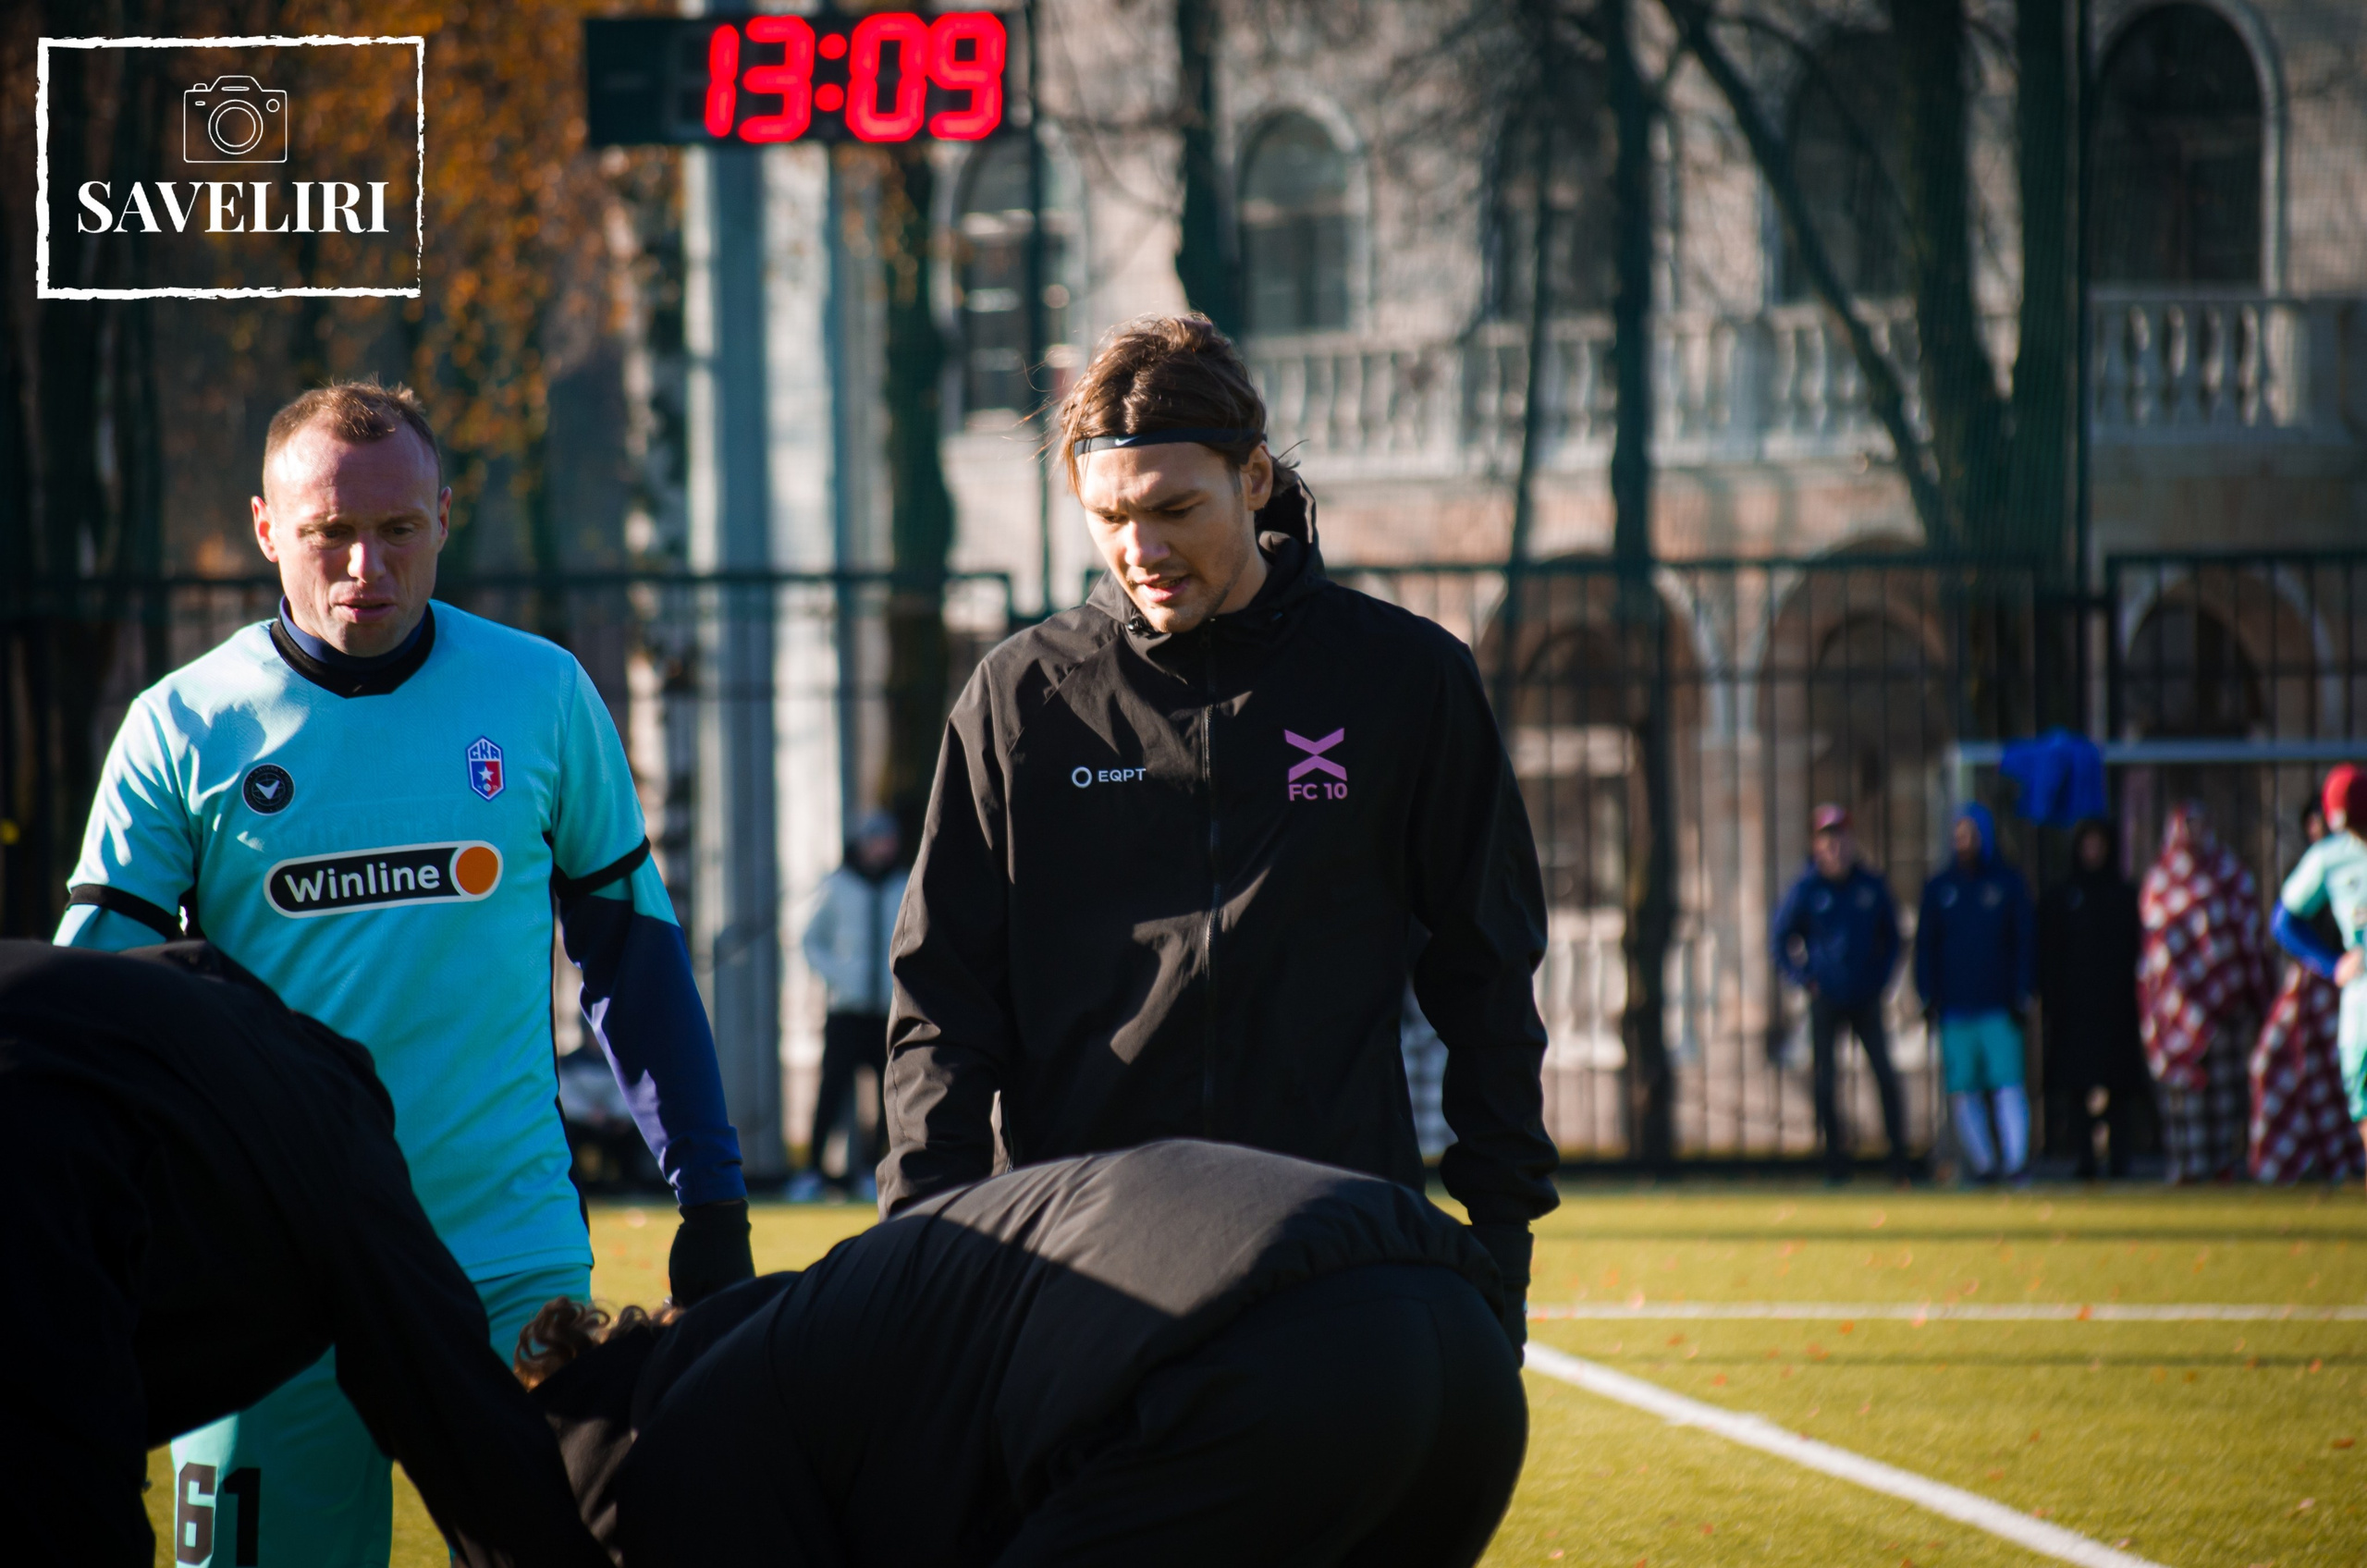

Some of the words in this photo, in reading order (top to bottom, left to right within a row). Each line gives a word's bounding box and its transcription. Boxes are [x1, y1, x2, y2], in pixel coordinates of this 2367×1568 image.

[705, 11, 1007, 143] 13:09
[1098, 767, 1147, 783] EQPT
[1288, 784, 1318, 802] FC
[1323, 782, 1348, 801] 10
[284, 862, 441, 904] Winline
[176, 1461, 263, 1568] 61
